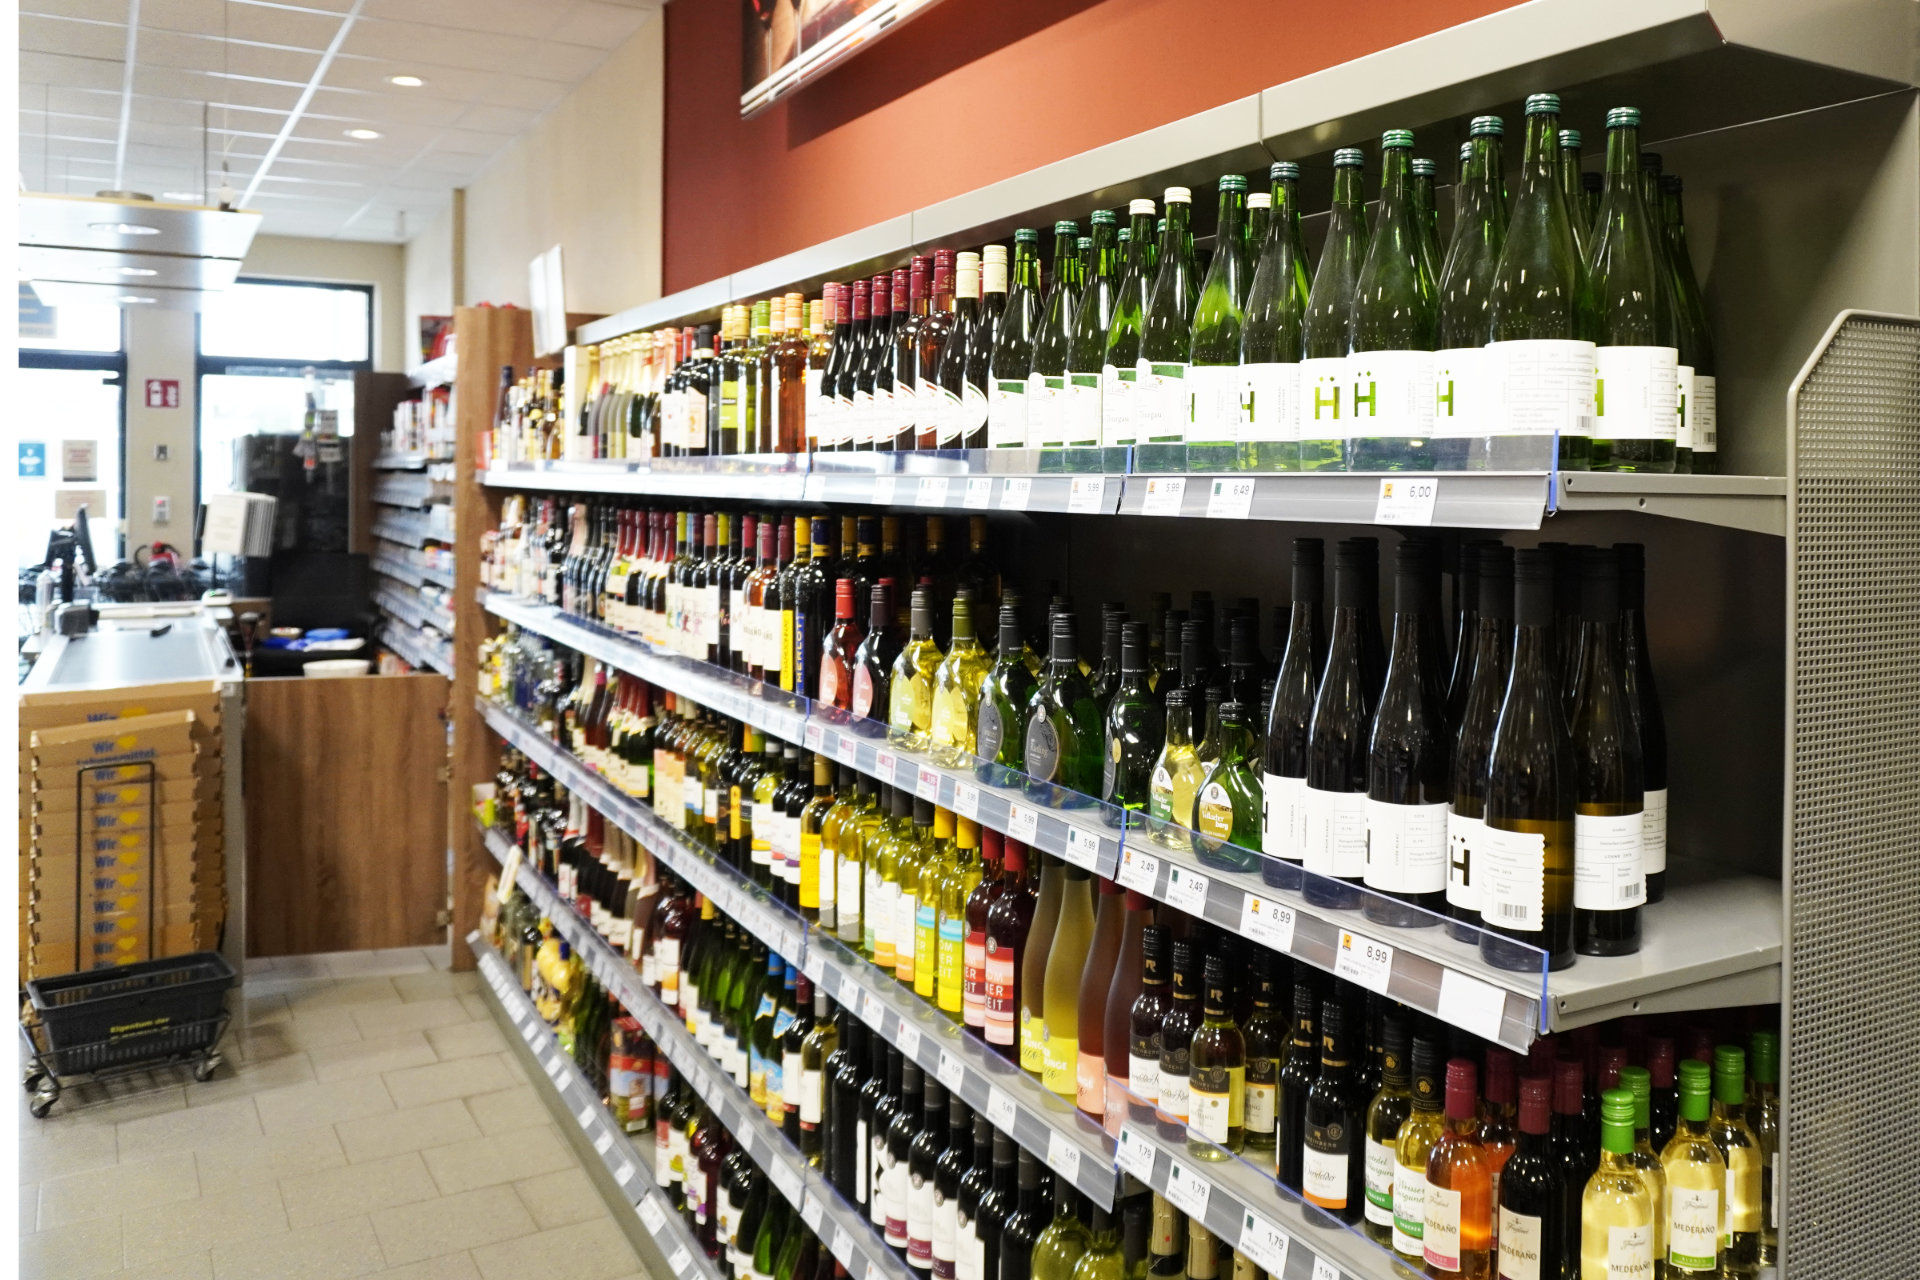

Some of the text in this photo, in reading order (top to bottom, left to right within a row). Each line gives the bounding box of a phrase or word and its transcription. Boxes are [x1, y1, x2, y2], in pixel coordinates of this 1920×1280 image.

[1232, 484, 1250, 498] 6,49
[1409, 485, 1432, 499] 6,00
[1140, 859, 1155, 873] 2,49
[1188, 878, 1204, 893] 2,49
[1272, 908, 1292, 925] 8,99
[1366, 945, 1387, 964] 8,99
[1138, 1143, 1152, 1159] 1,79
[1191, 1180, 1206, 1197] 1,79
[1673, 1222, 1716, 1234] MEDERAÑO
[1267, 1232, 1284, 1250] 1,79
[1611, 1260, 1651, 1274] MEDERAÑO
